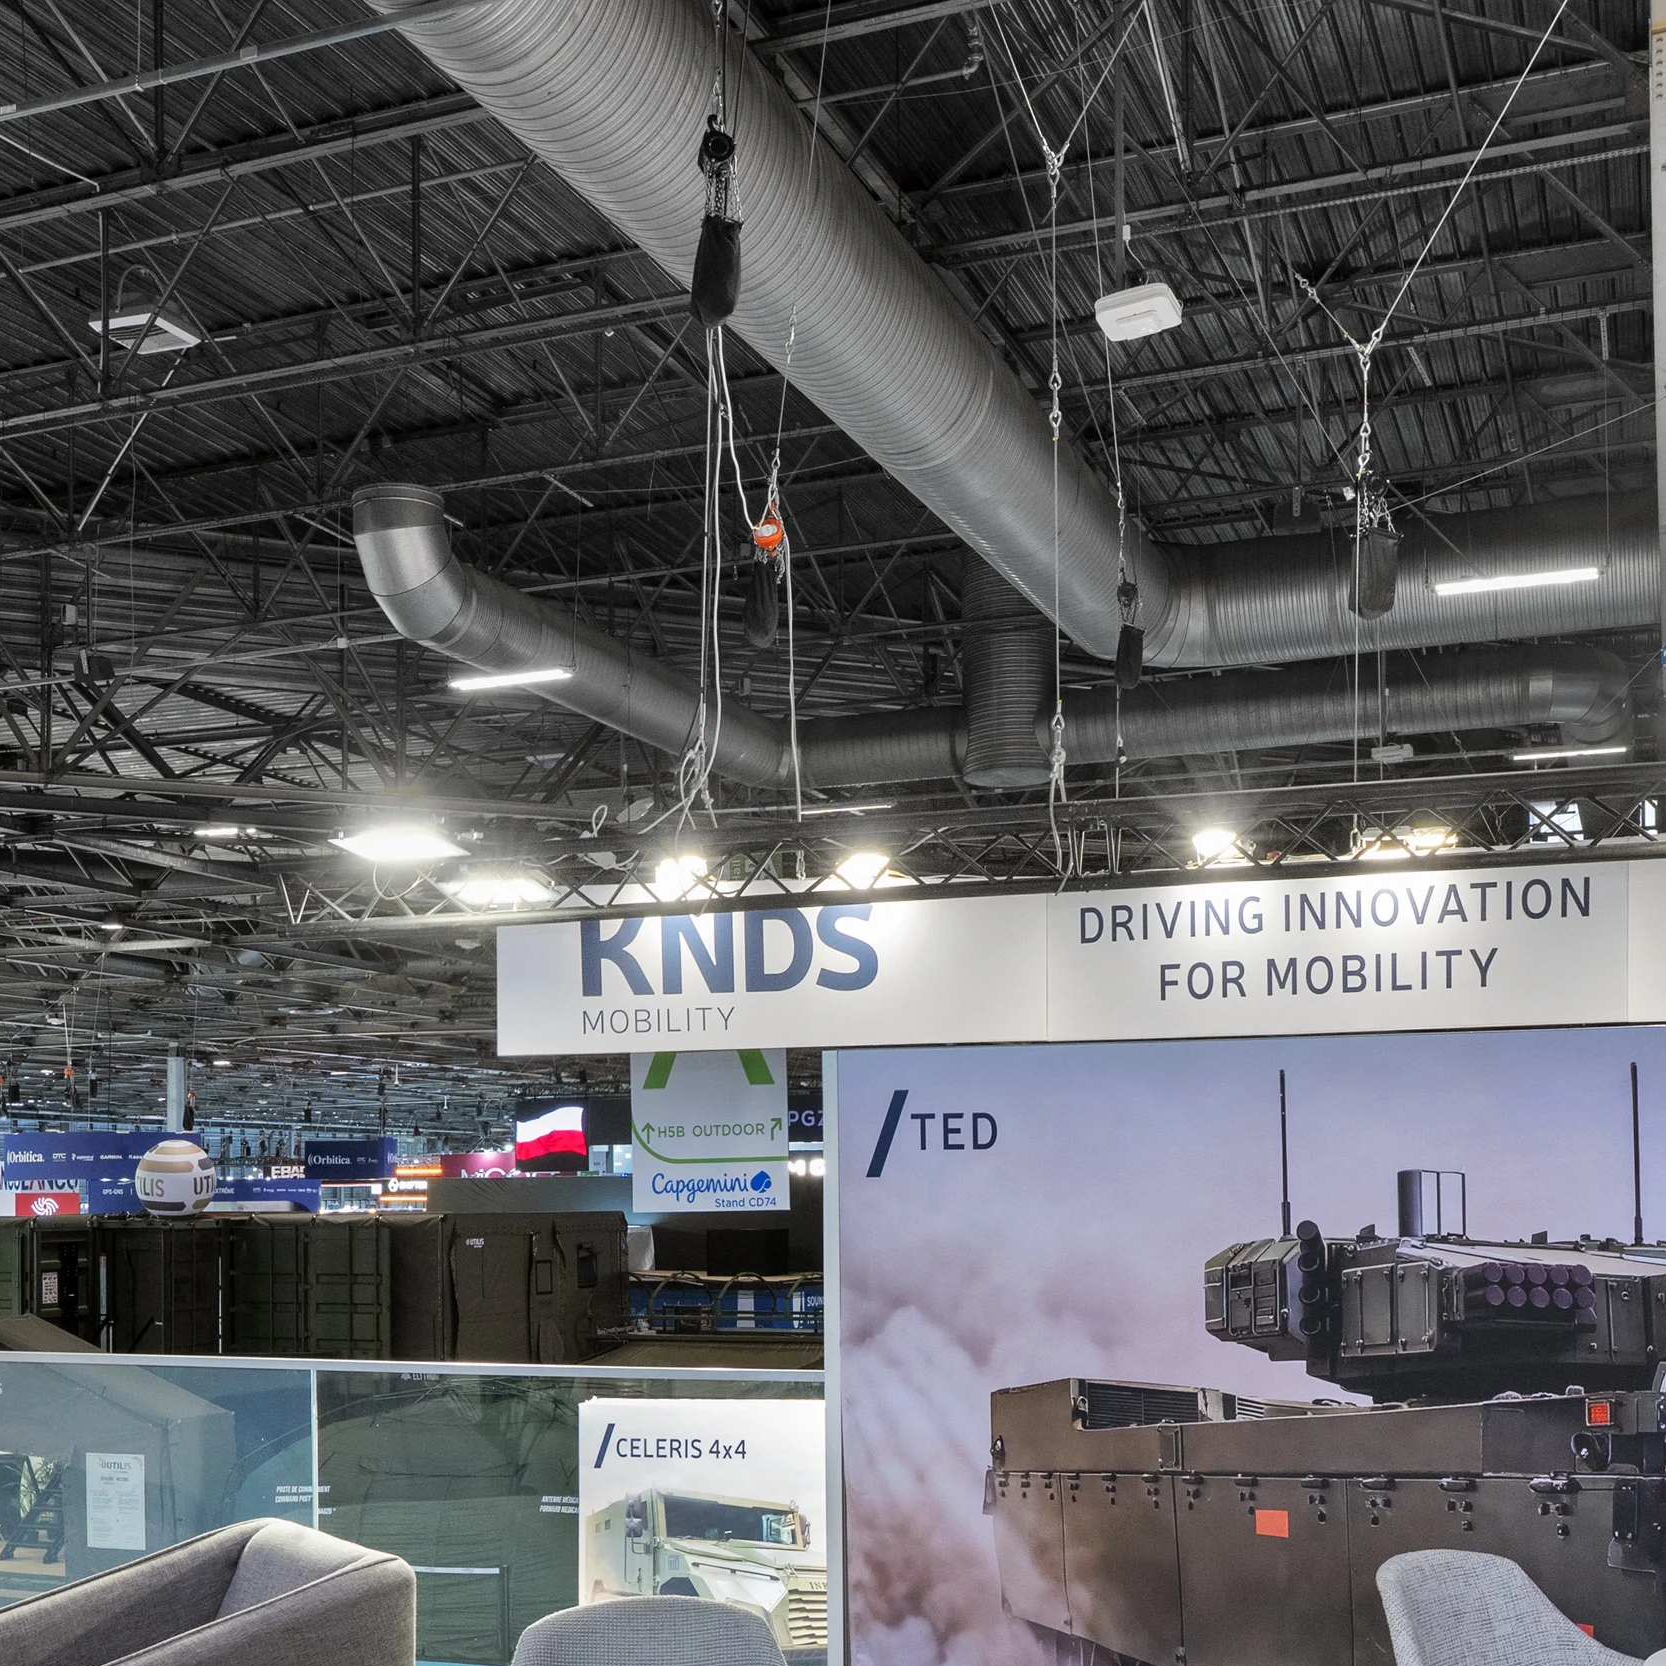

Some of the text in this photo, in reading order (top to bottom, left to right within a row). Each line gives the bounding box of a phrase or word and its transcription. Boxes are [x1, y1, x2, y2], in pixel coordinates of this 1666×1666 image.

[1079, 876, 1591, 944] DRIVING INNOVATION
[582, 903, 879, 997] KNDS
[1159, 947, 1499, 1001] FOR MOBILITY
[582, 1006, 736, 1035] MOBILITY
[657, 1123, 765, 1138] H5B OUTDOOR
[651, 1173, 749, 1204] Capgemini
[714, 1197, 777, 1208] Stand CD74
[616, 1438, 747, 1459] CELERIS 4x4
